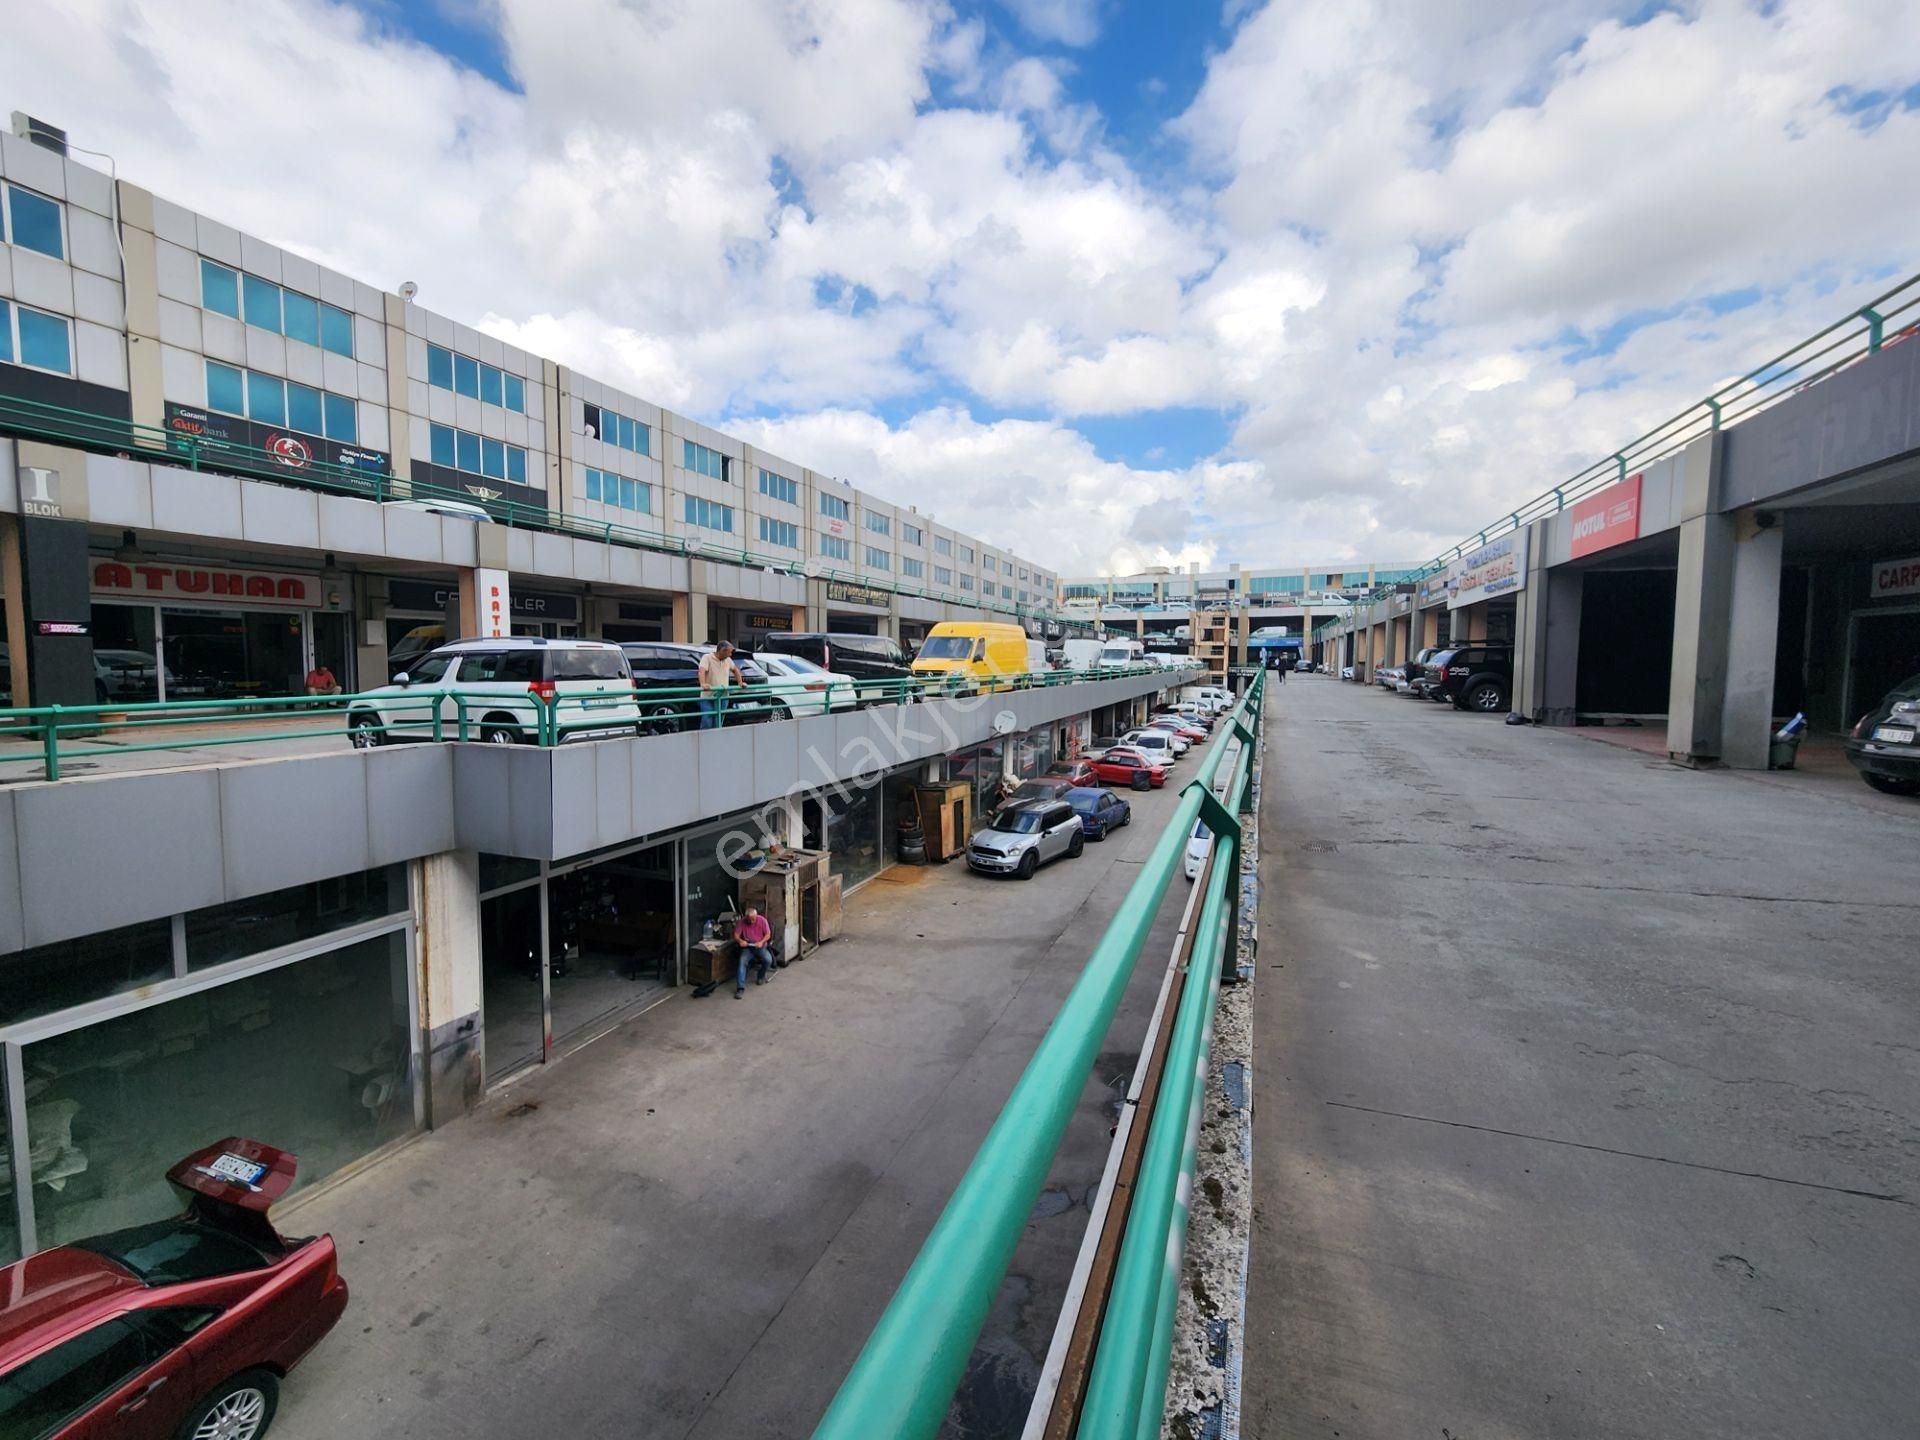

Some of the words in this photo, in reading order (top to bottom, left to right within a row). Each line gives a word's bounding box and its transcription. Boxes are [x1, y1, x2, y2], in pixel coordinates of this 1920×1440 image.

[180, 409, 207, 422] Garanti
[203, 425, 229, 438] bank
[24, 502, 61, 517] BLOK
[1572, 511, 1606, 540] MOTUL
[1032, 621, 1042, 633] MS
[1047, 623, 1060, 635] CAR
